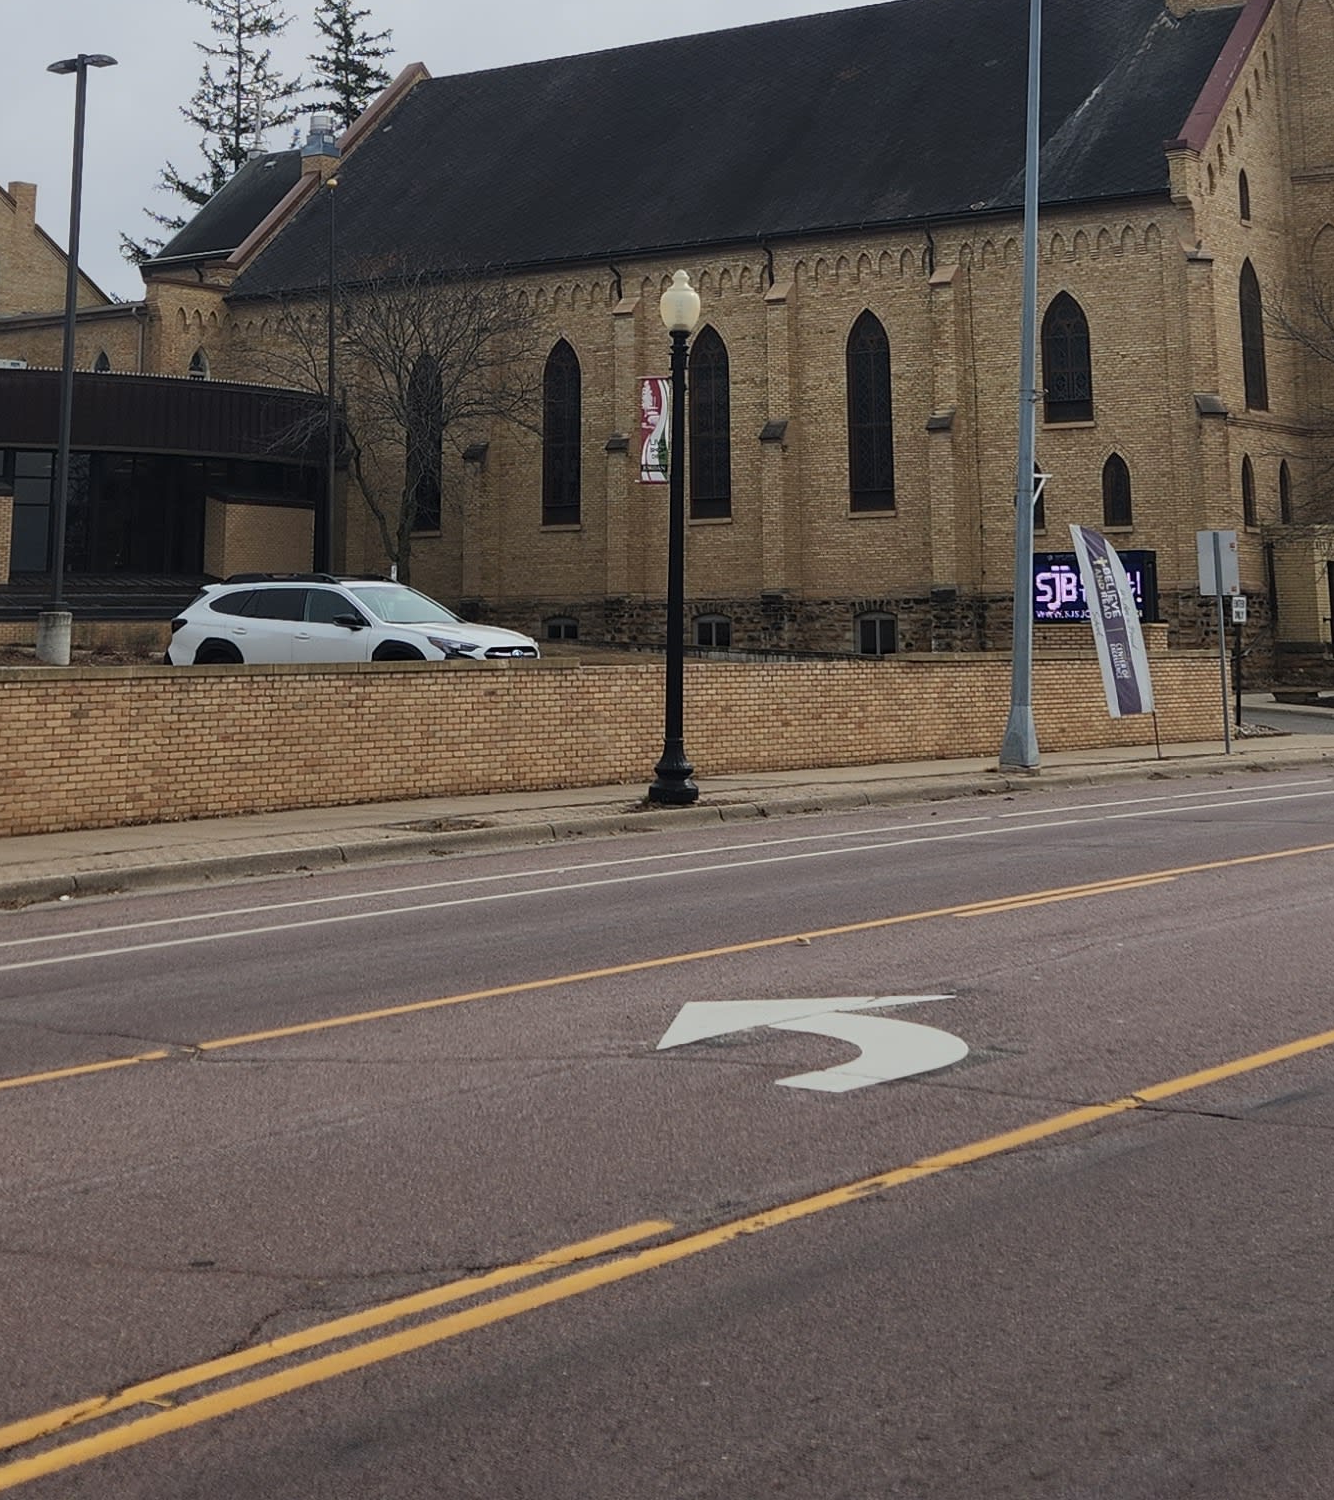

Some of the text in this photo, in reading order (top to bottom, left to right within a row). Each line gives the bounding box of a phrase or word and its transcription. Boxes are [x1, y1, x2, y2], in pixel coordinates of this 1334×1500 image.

[1035, 565, 1078, 610] SJB
[1094, 568, 1112, 619] AND READ
[1102, 567, 1121, 618] BELIEVE
